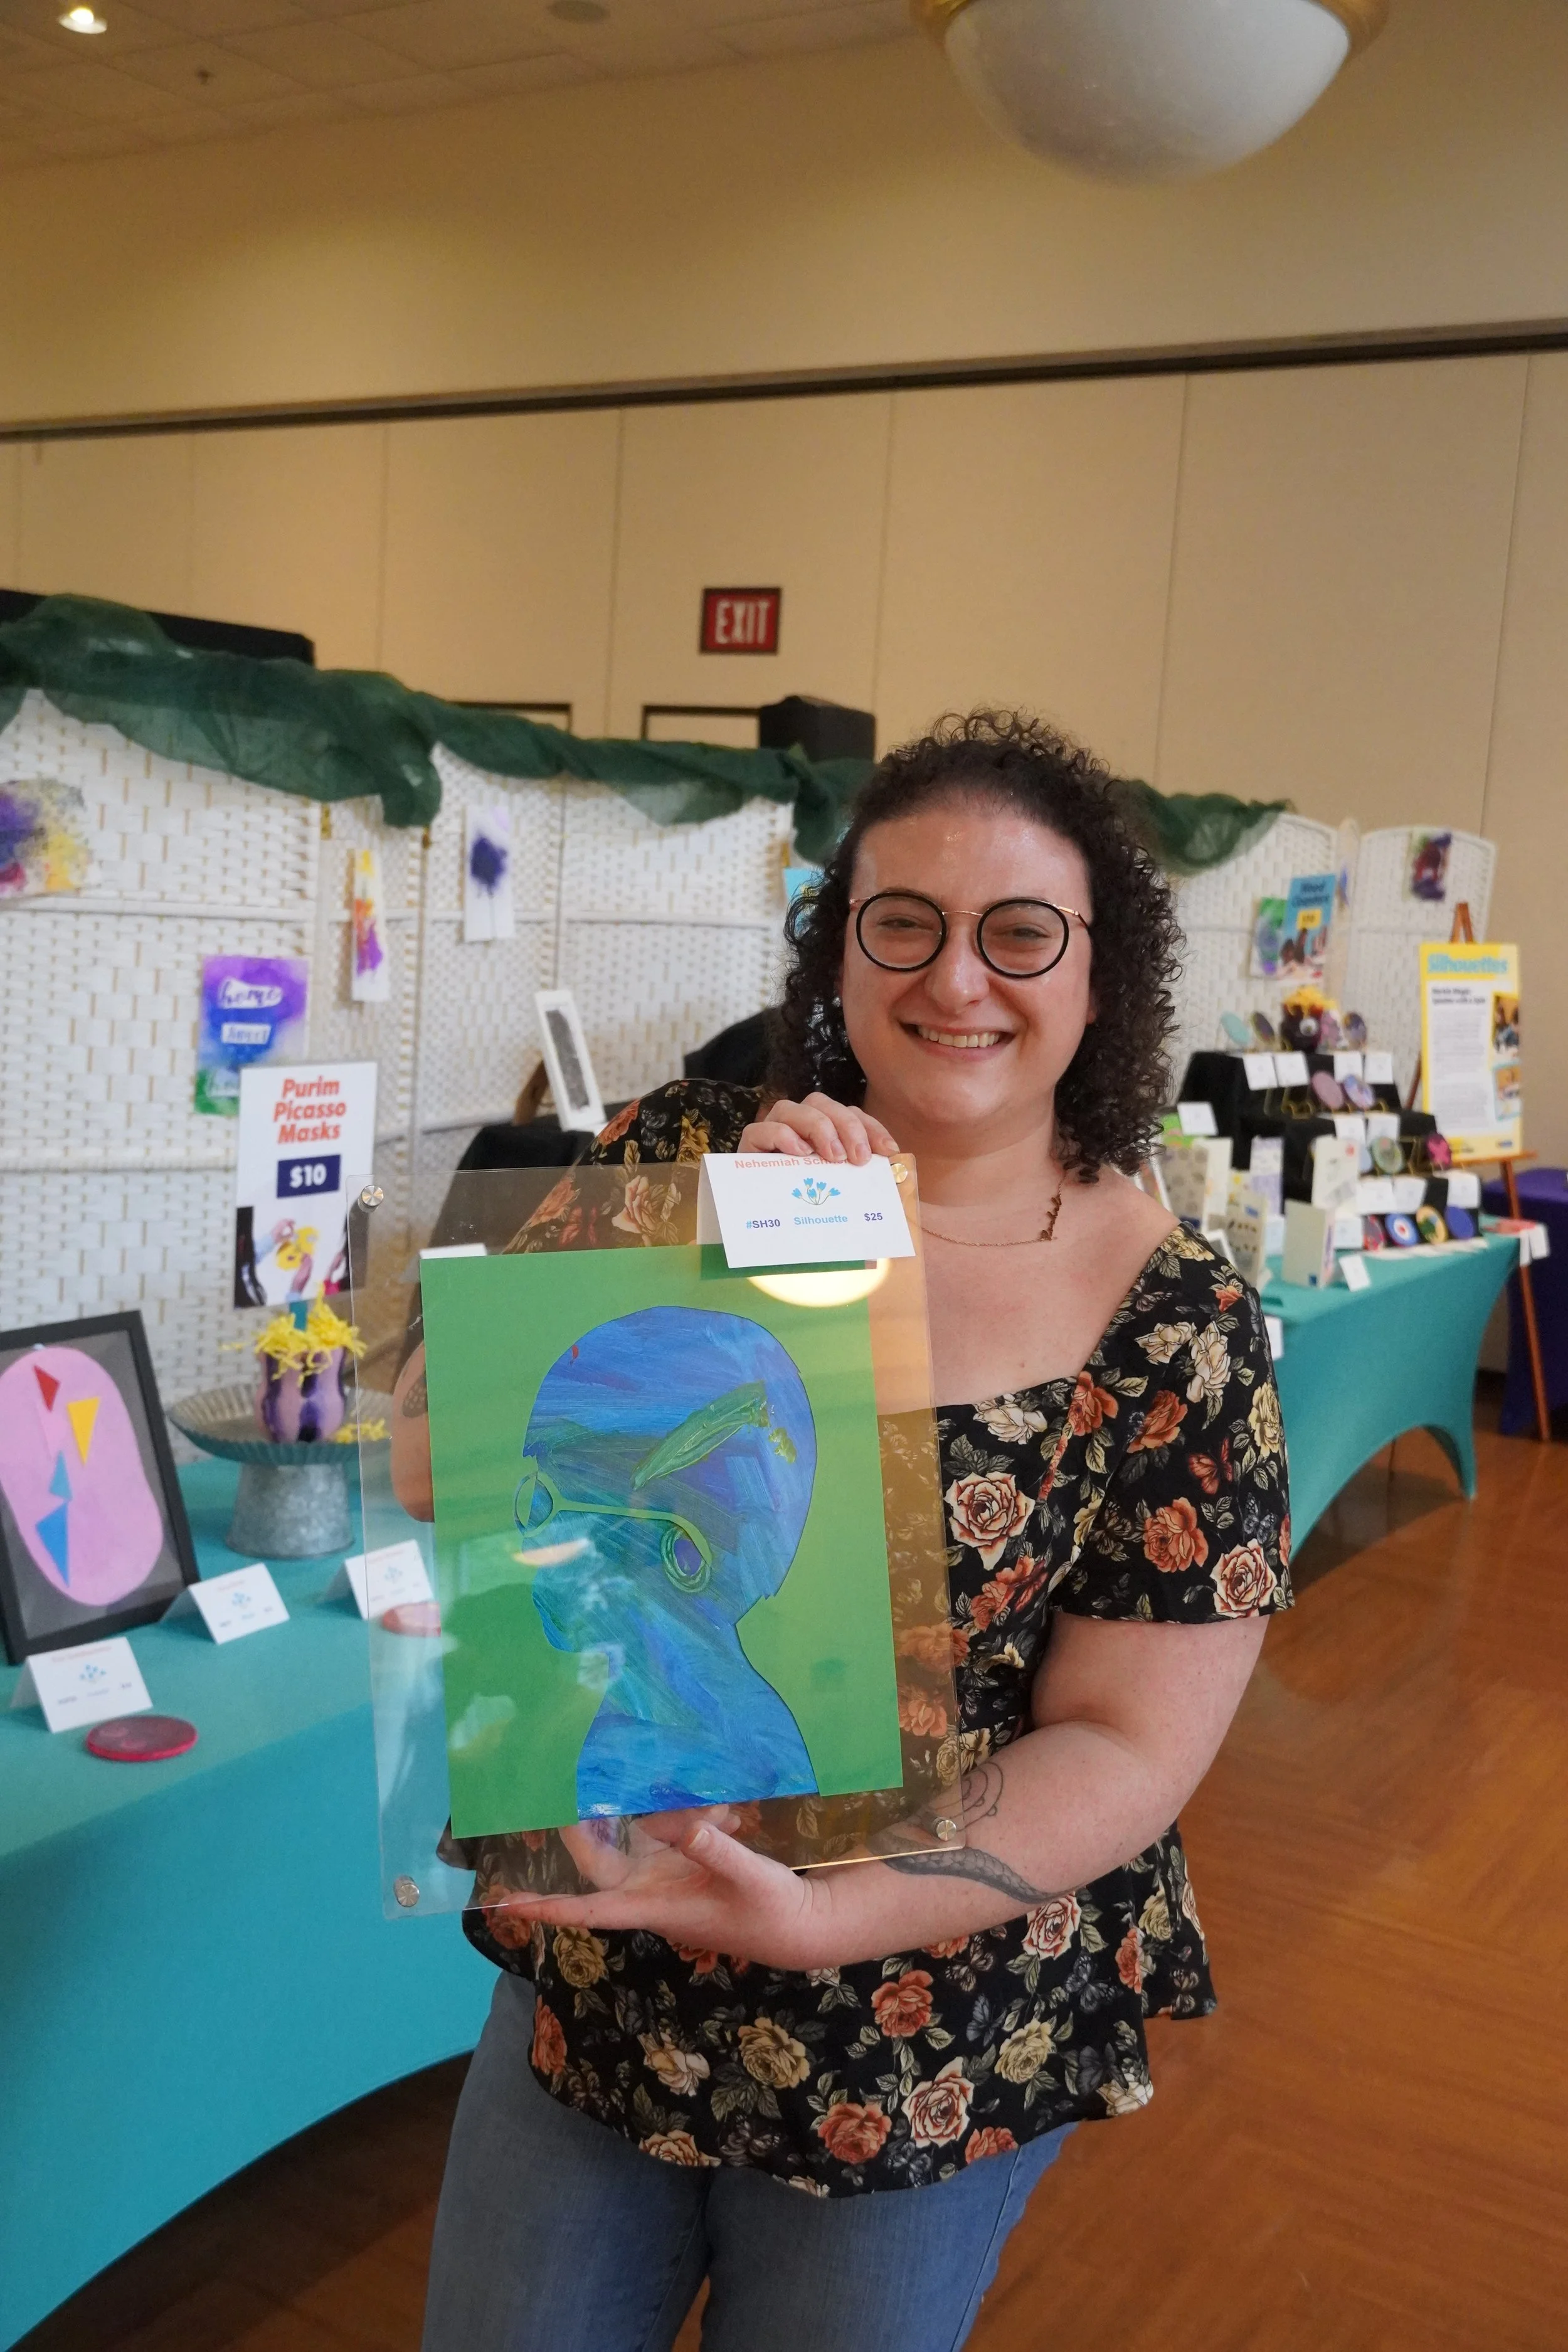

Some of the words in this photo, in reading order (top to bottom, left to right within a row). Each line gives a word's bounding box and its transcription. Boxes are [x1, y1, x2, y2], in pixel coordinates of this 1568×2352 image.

[715, 600, 769, 644] EXIT
[283, 1076, 339, 1098] Purim
[273, 1101, 346, 1121] Picasso
[278, 1123, 340, 1143] Masks
[734, 1157, 800, 1168] Nehemiah
[746, 1219, 781, 1229] #SH30
[793, 1214, 848, 1226] Silhouette
[864, 1212, 883, 1222] $25
